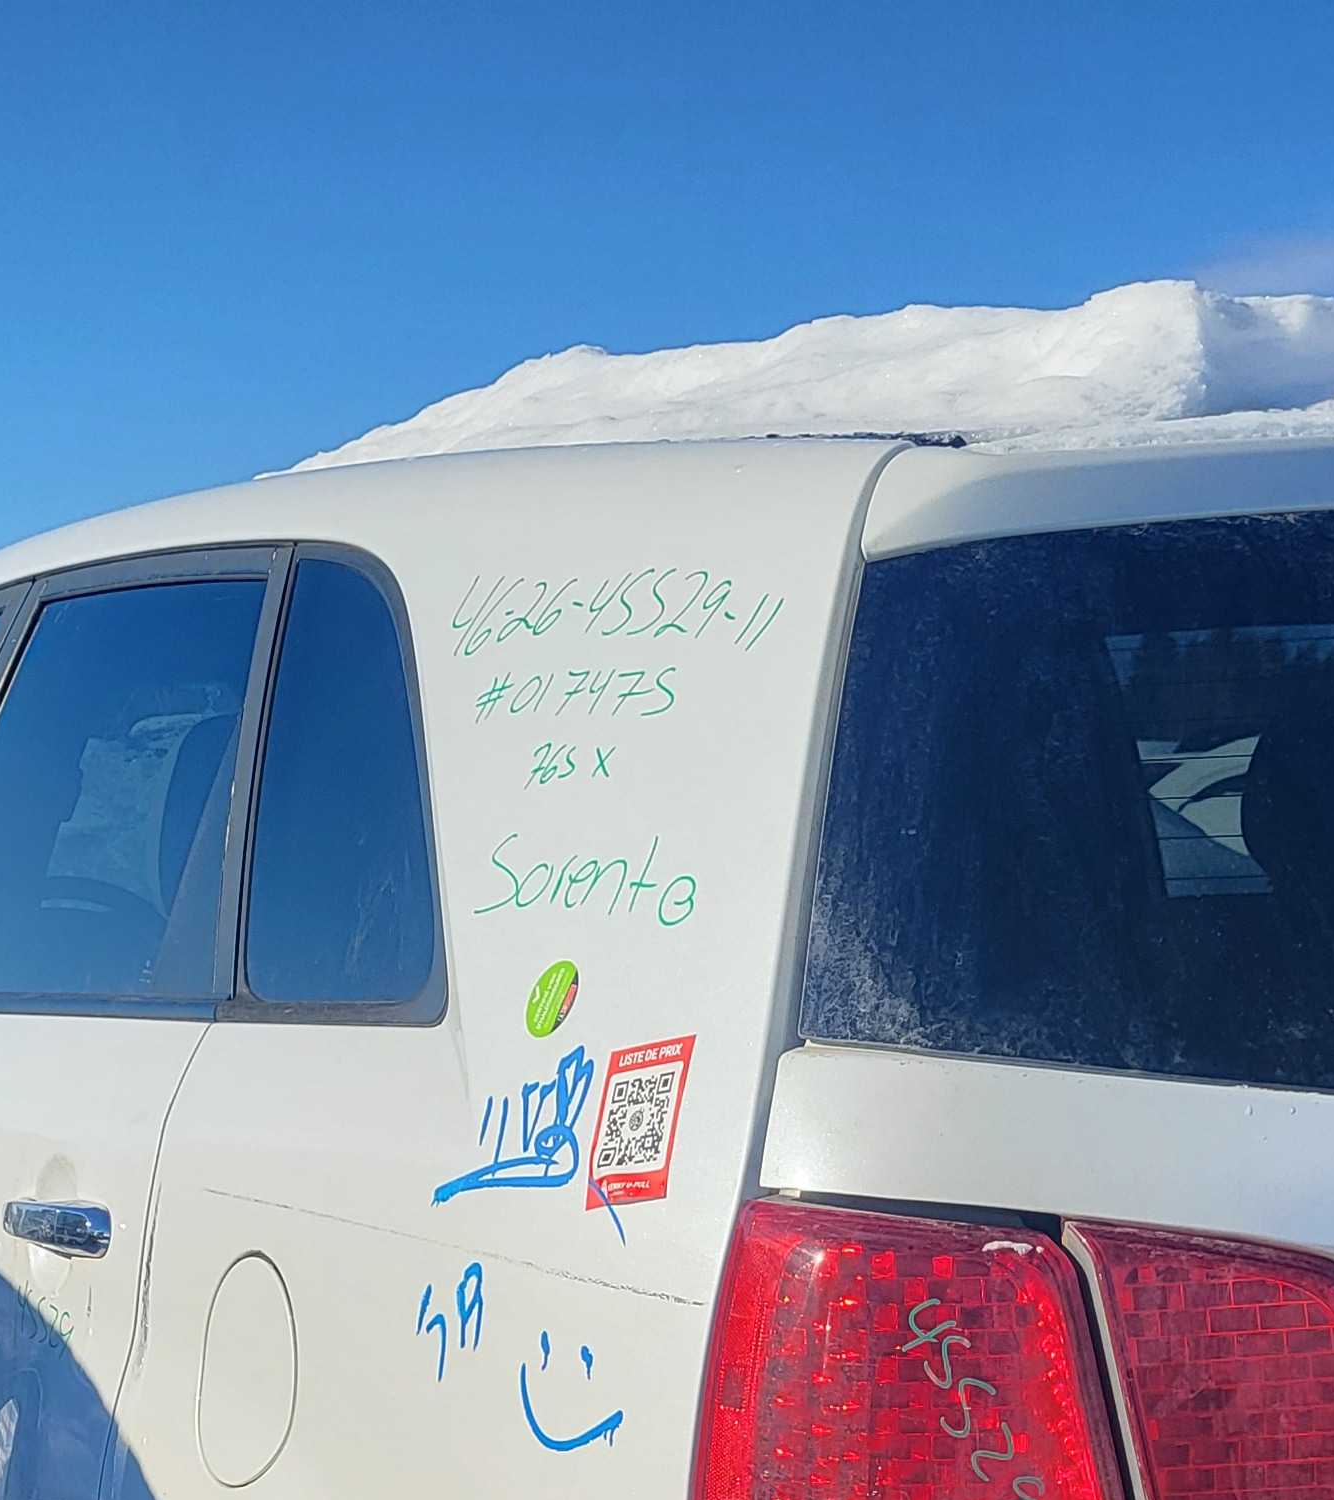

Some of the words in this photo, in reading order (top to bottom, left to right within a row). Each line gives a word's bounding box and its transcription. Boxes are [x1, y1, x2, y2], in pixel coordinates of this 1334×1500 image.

[618, 1050, 645, 1067] LISTE
[644, 1047, 659, 1062] DE
[658, 1043, 683, 1059] PRIX
